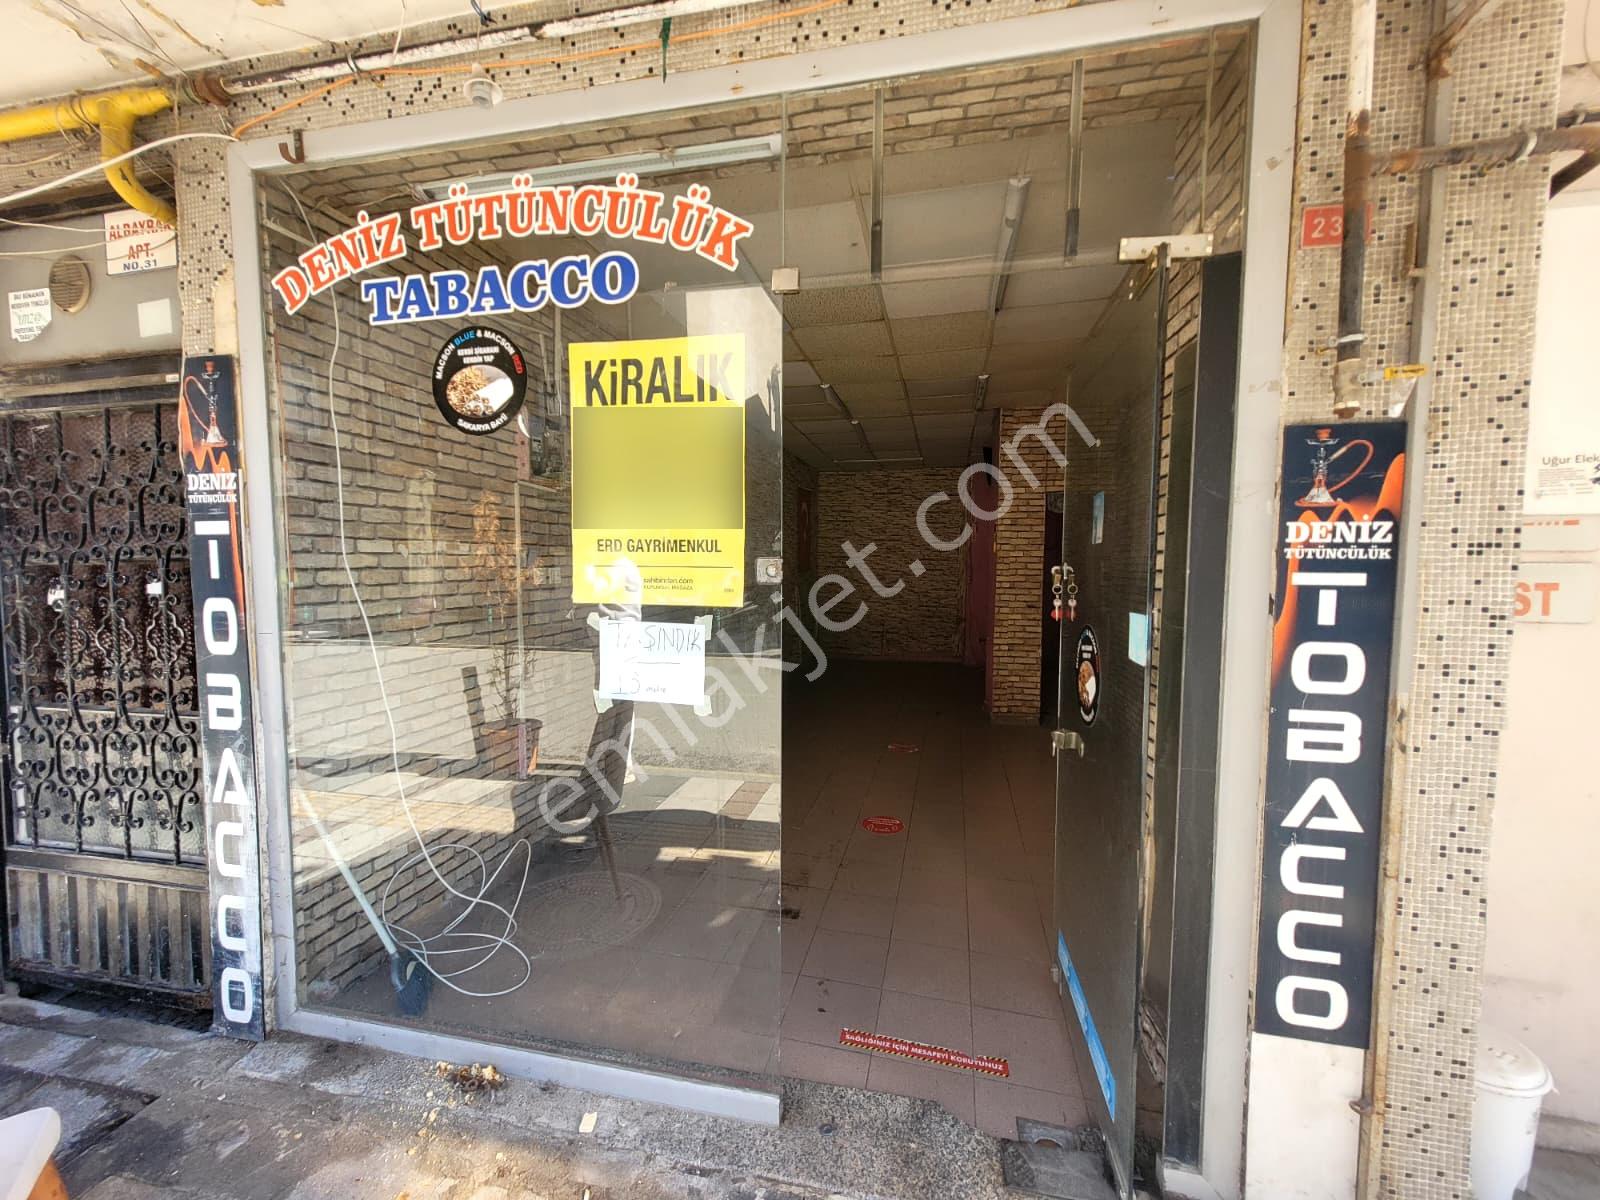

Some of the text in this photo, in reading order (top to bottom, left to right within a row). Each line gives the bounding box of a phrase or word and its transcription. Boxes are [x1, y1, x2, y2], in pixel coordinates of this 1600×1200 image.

[127, 242, 154, 260] APT.
[271, 173, 754, 316] DENİZ TÜTÜNCÜLÜK
[362, 250, 639, 326] TABACCO
[435, 343, 456, 380] MACSON
[454, 330, 475, 346] BLUE
[484, 330, 516, 356] MACSON
[597, 536, 723, 553] ERD GAYRİMENKUL
[1284, 545, 1392, 560] TÜTÜNCÜLÜK
[1285, 514, 1394, 543] DENİZ
[194, 520, 253, 1025] TOBACCO
[1275, 572, 1368, 1031] TOBACCO
